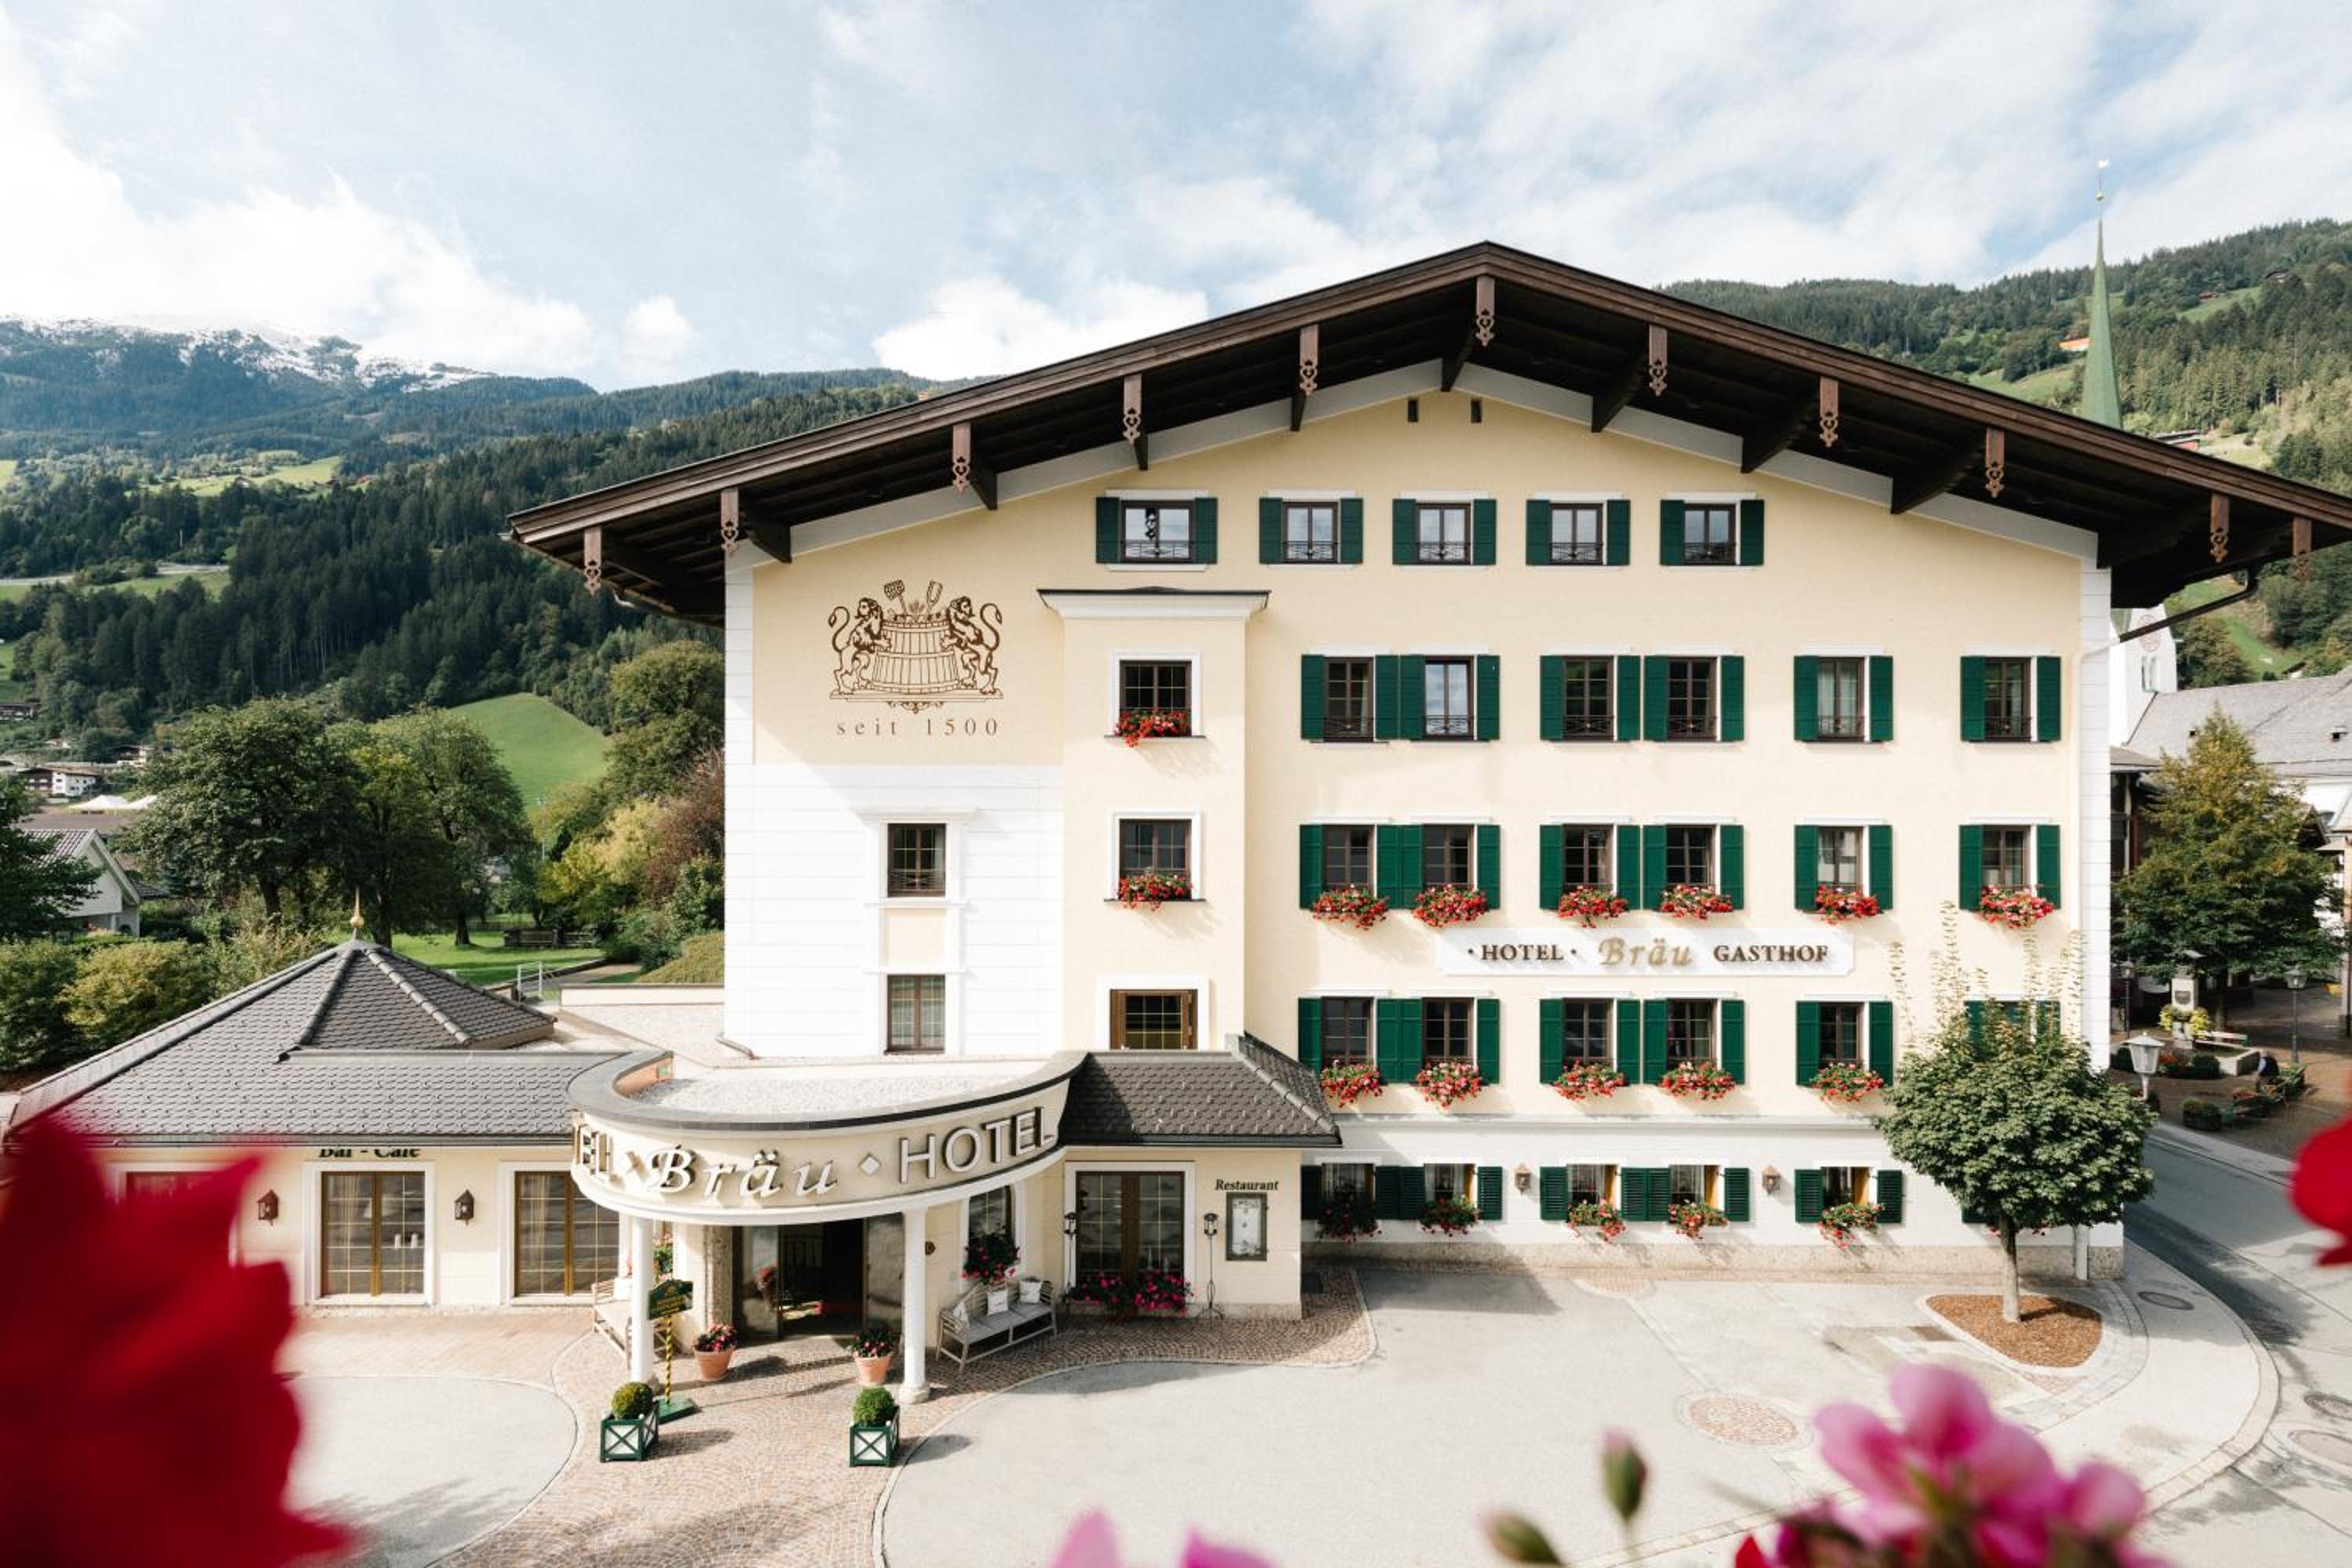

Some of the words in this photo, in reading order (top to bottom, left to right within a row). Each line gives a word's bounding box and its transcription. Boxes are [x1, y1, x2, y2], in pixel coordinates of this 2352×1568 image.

[836, 717, 897, 735] seit
[927, 718, 998, 735] 1500
[1481, 943, 1565, 961] HOTEL
[1597, 936, 1693, 967] Bräu
[1712, 945, 1829, 962] GASTHOF
[646, 1145, 838, 1197] Bräu
[899, 1106, 1055, 1184] HOTEL
[1215, 1179, 1279, 1190] Restaurant
